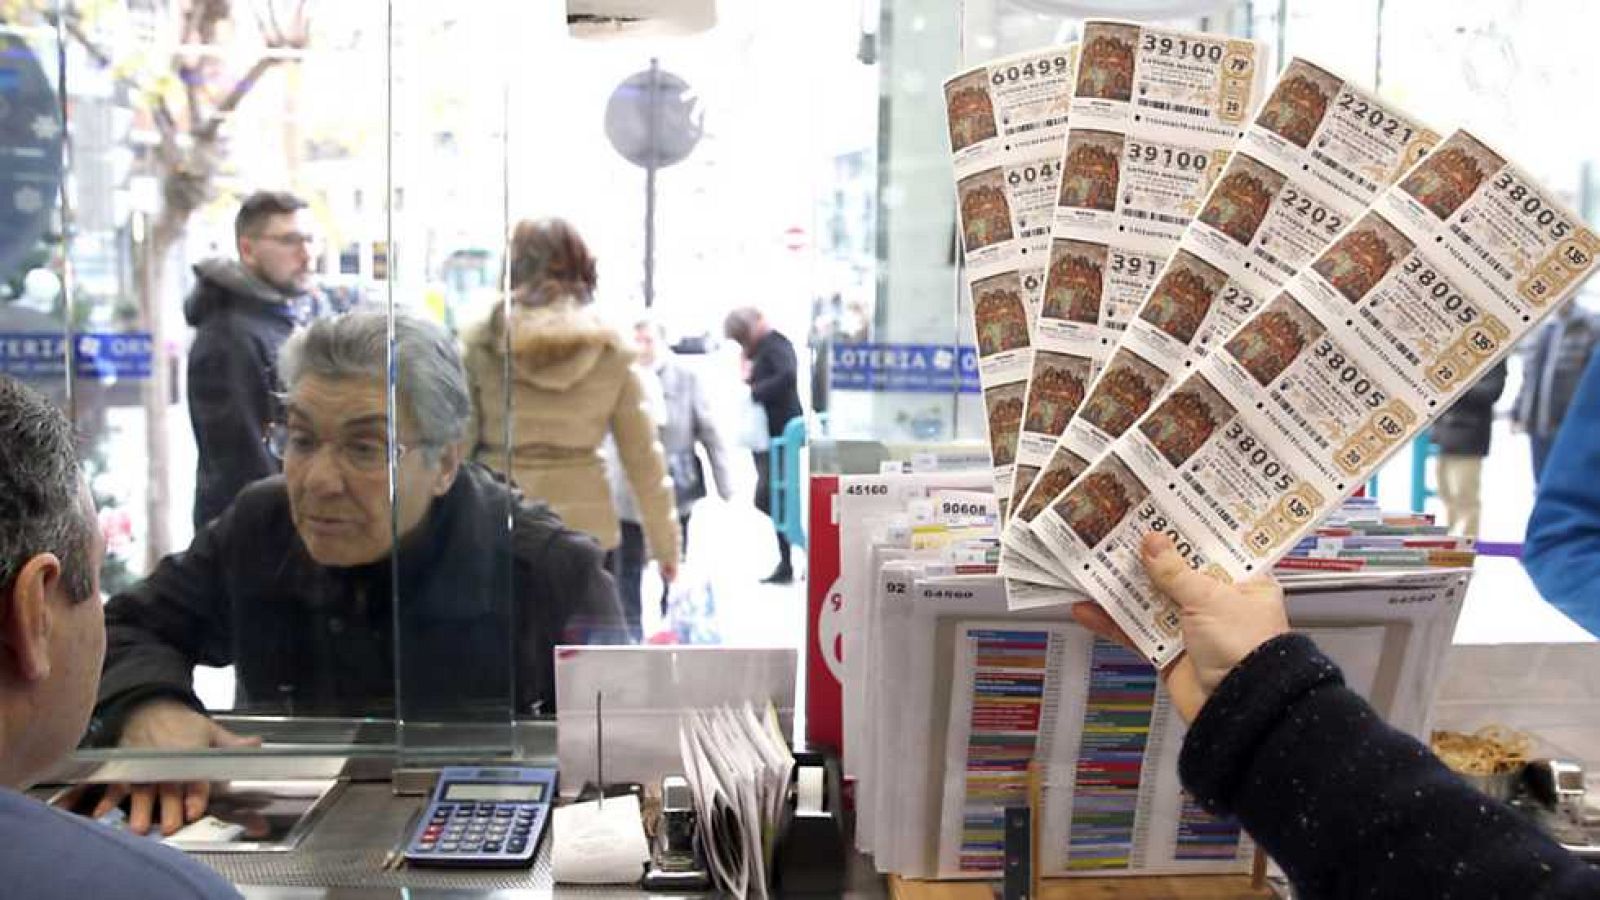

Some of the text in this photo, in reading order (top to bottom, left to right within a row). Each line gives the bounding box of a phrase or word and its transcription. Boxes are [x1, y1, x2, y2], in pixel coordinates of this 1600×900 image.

[992, 56, 1067, 85] 60499
[1143, 34, 1222, 61] 39100
[1339, 93, 1412, 143] 22021
[1128, 143, 1207, 170] 39100
[1495, 173, 1570, 237] 38005
[1404, 257, 1477, 323] 38005
[1315, 340, 1385, 407] 38005
[1225, 423, 1293, 490] 38005
